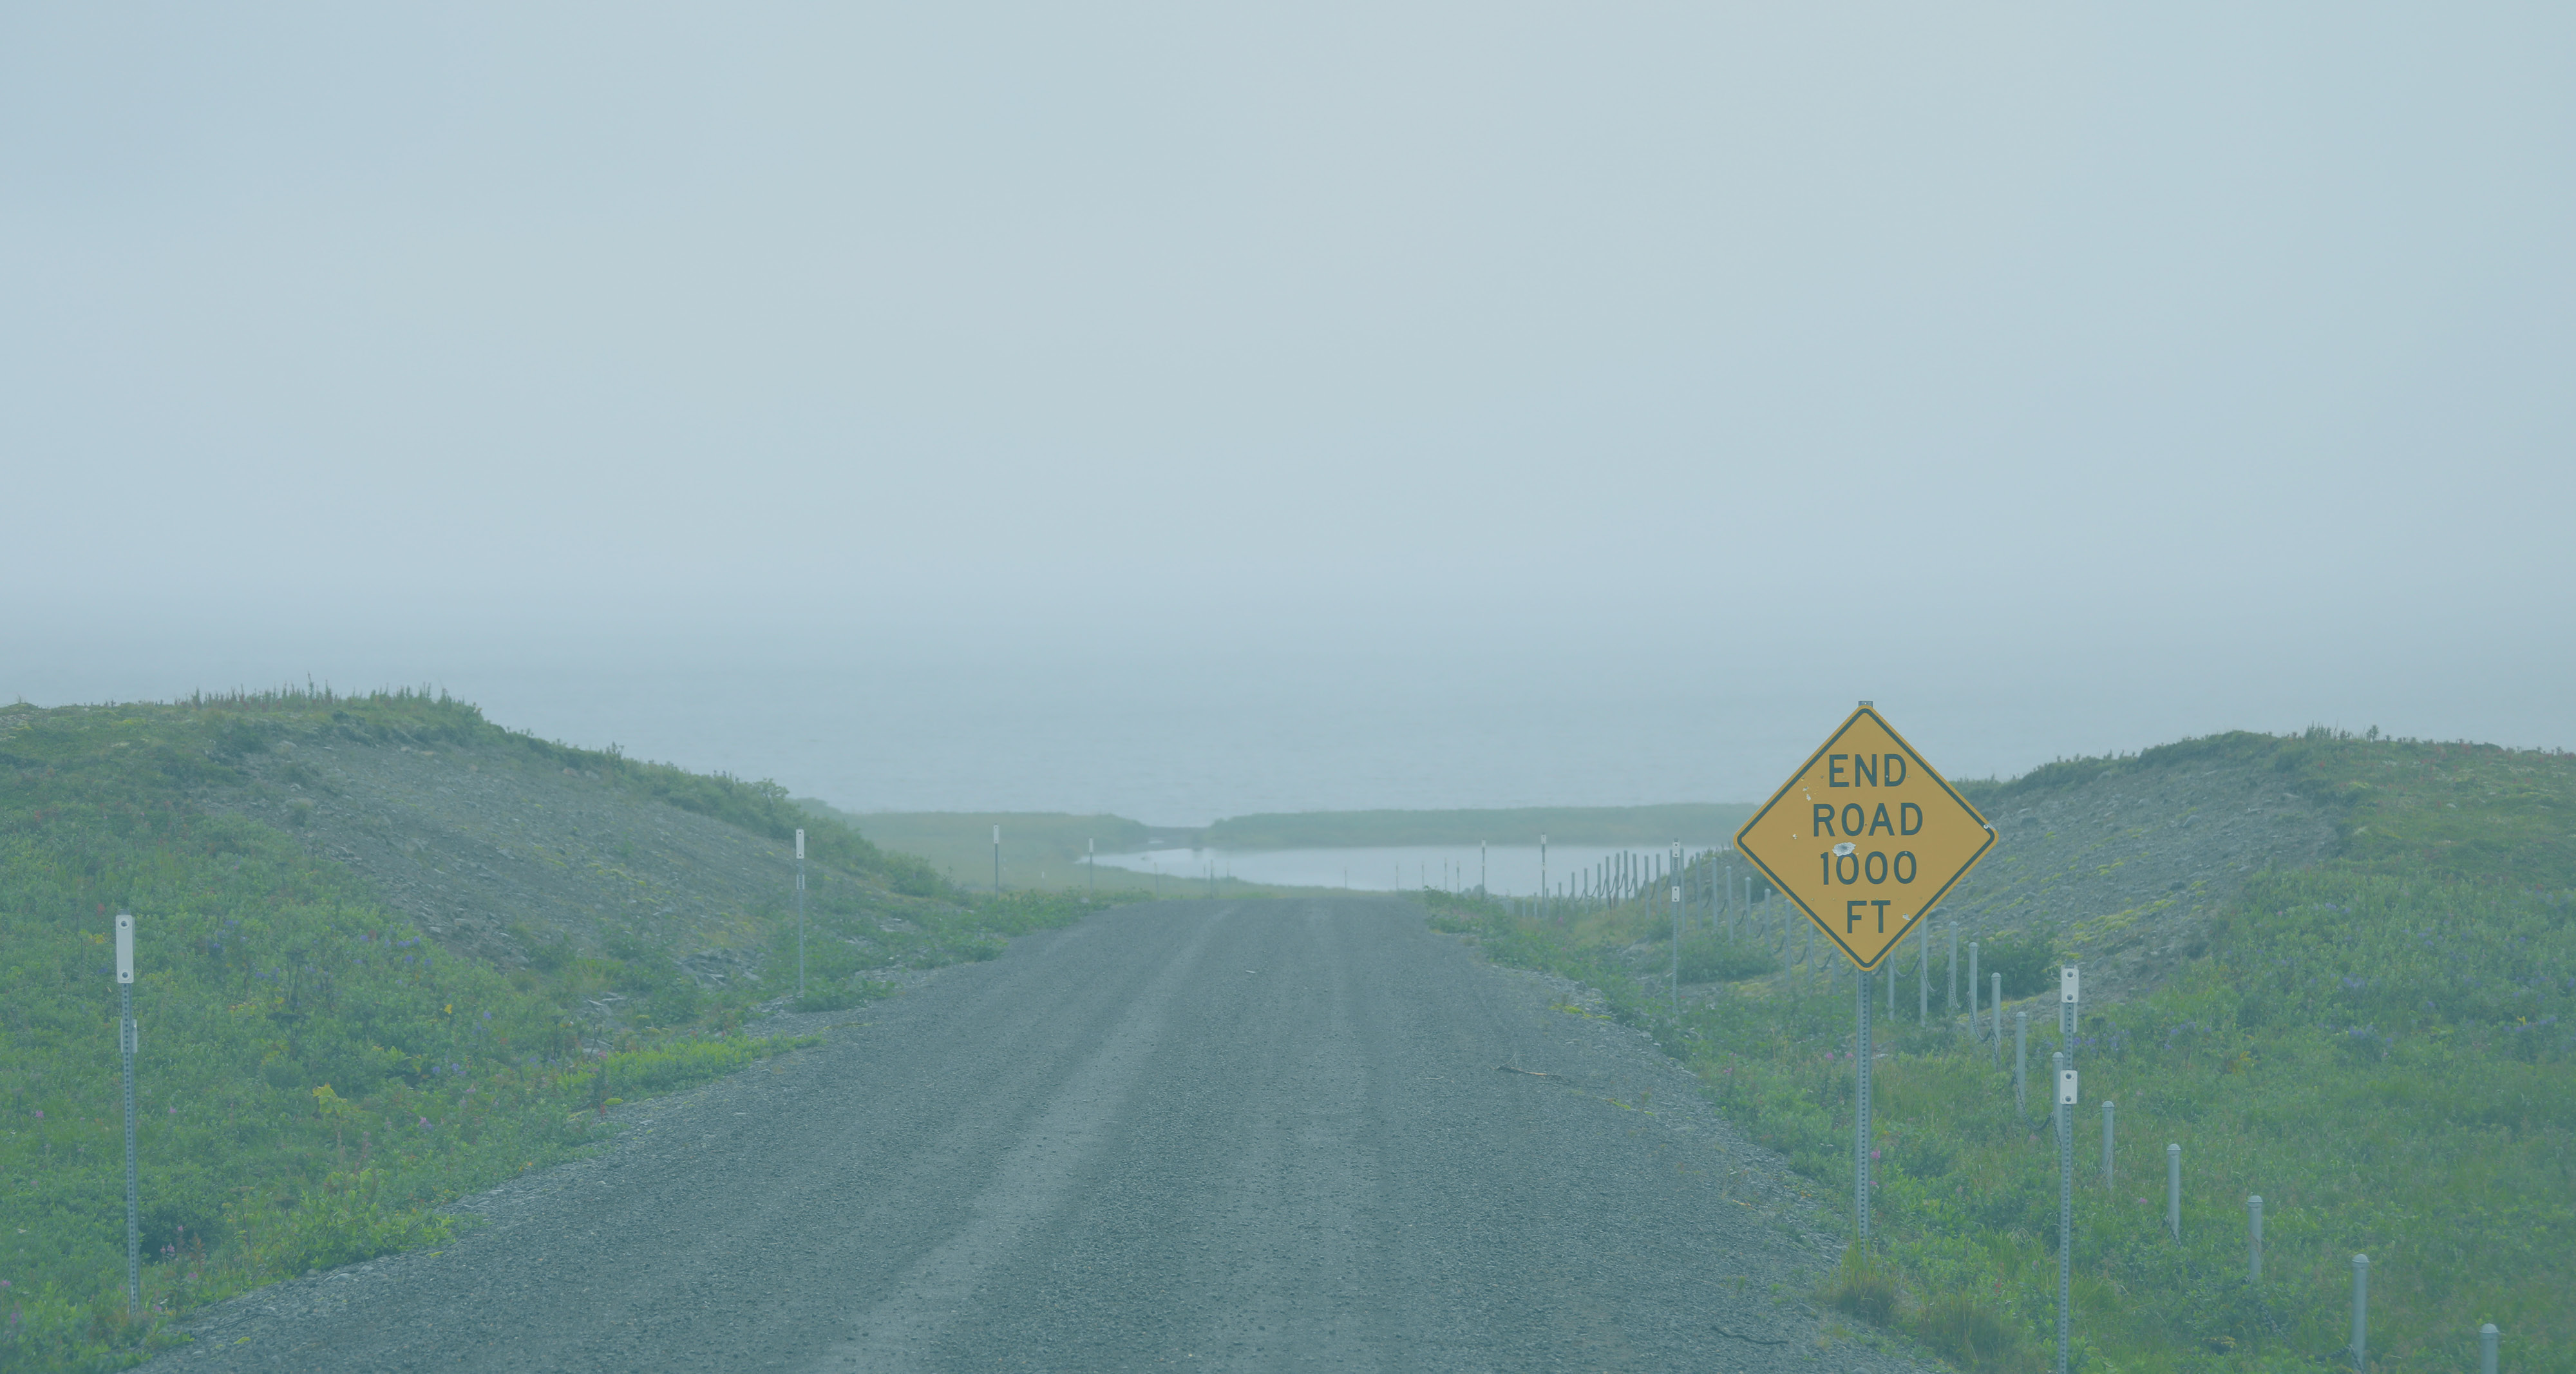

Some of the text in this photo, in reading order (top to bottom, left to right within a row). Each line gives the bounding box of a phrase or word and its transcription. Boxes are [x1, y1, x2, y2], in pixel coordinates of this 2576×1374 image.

[1828, 753, 1907, 788] END
[1813, 802, 1923, 837] ROAD
[1820, 850, 1917, 885] 1000
[1846, 900, 1891, 933] FT
